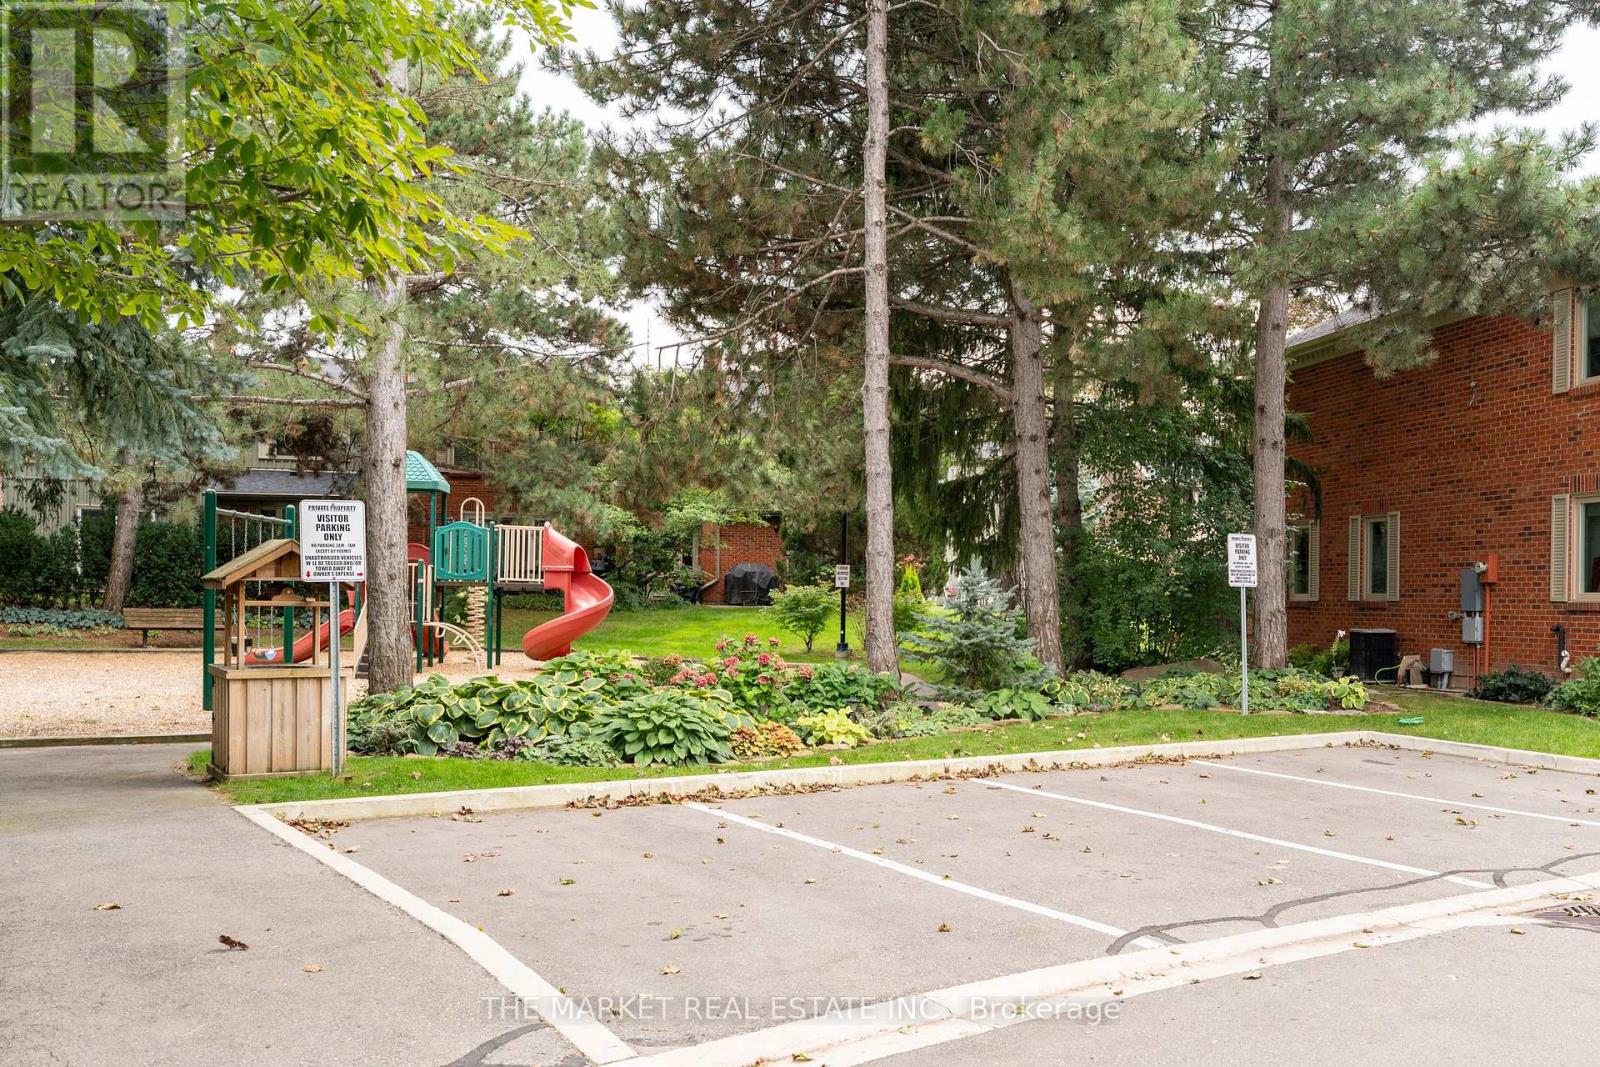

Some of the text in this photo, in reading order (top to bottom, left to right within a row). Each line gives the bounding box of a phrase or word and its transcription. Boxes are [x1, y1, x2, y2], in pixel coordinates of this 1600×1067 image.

[316, 514, 349, 522] VISITOR
[315, 523, 351, 531] PARKING
[323, 533, 343, 541] ONLY
